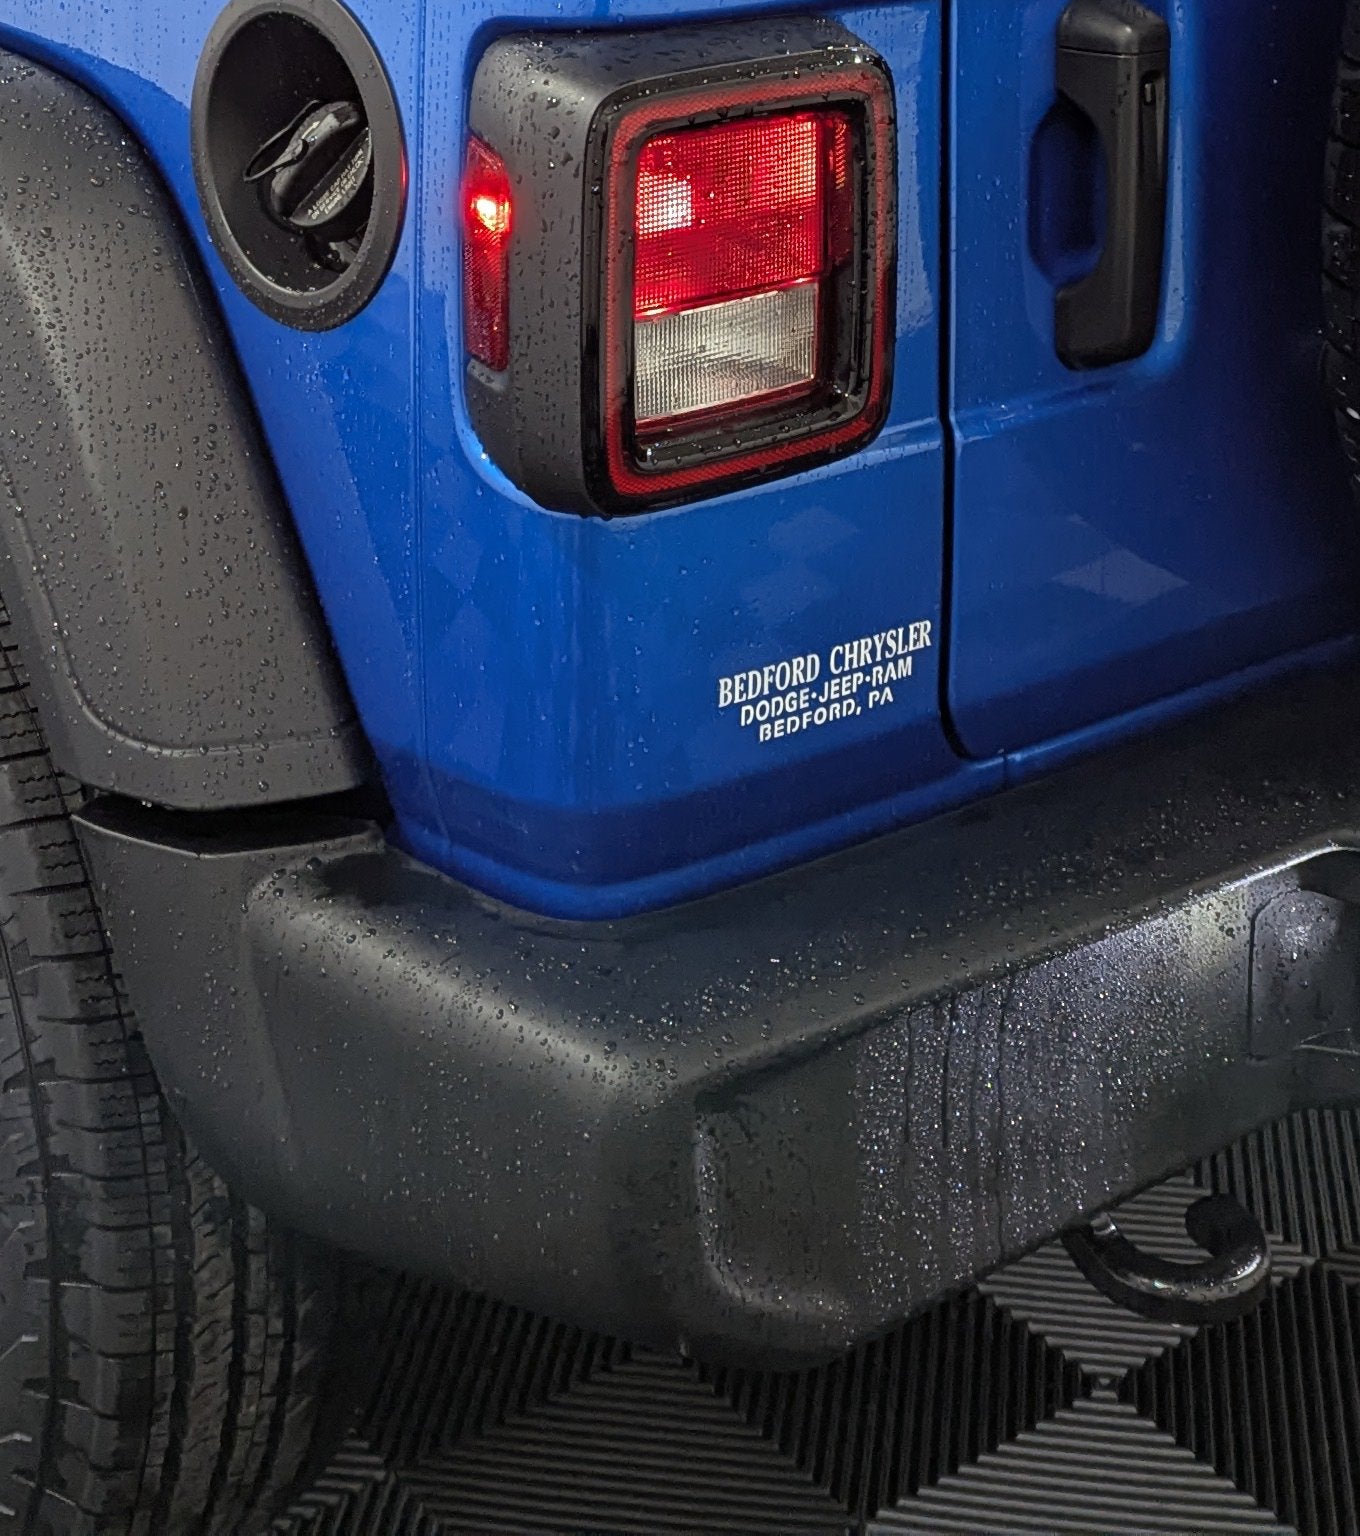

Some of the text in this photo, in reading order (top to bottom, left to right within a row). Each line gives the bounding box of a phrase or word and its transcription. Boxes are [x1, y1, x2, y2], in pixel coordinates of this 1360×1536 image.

[718, 619, 932, 708] BEDFORD CHRYSLER
[759, 686, 894, 743] BEDFORD, PA
